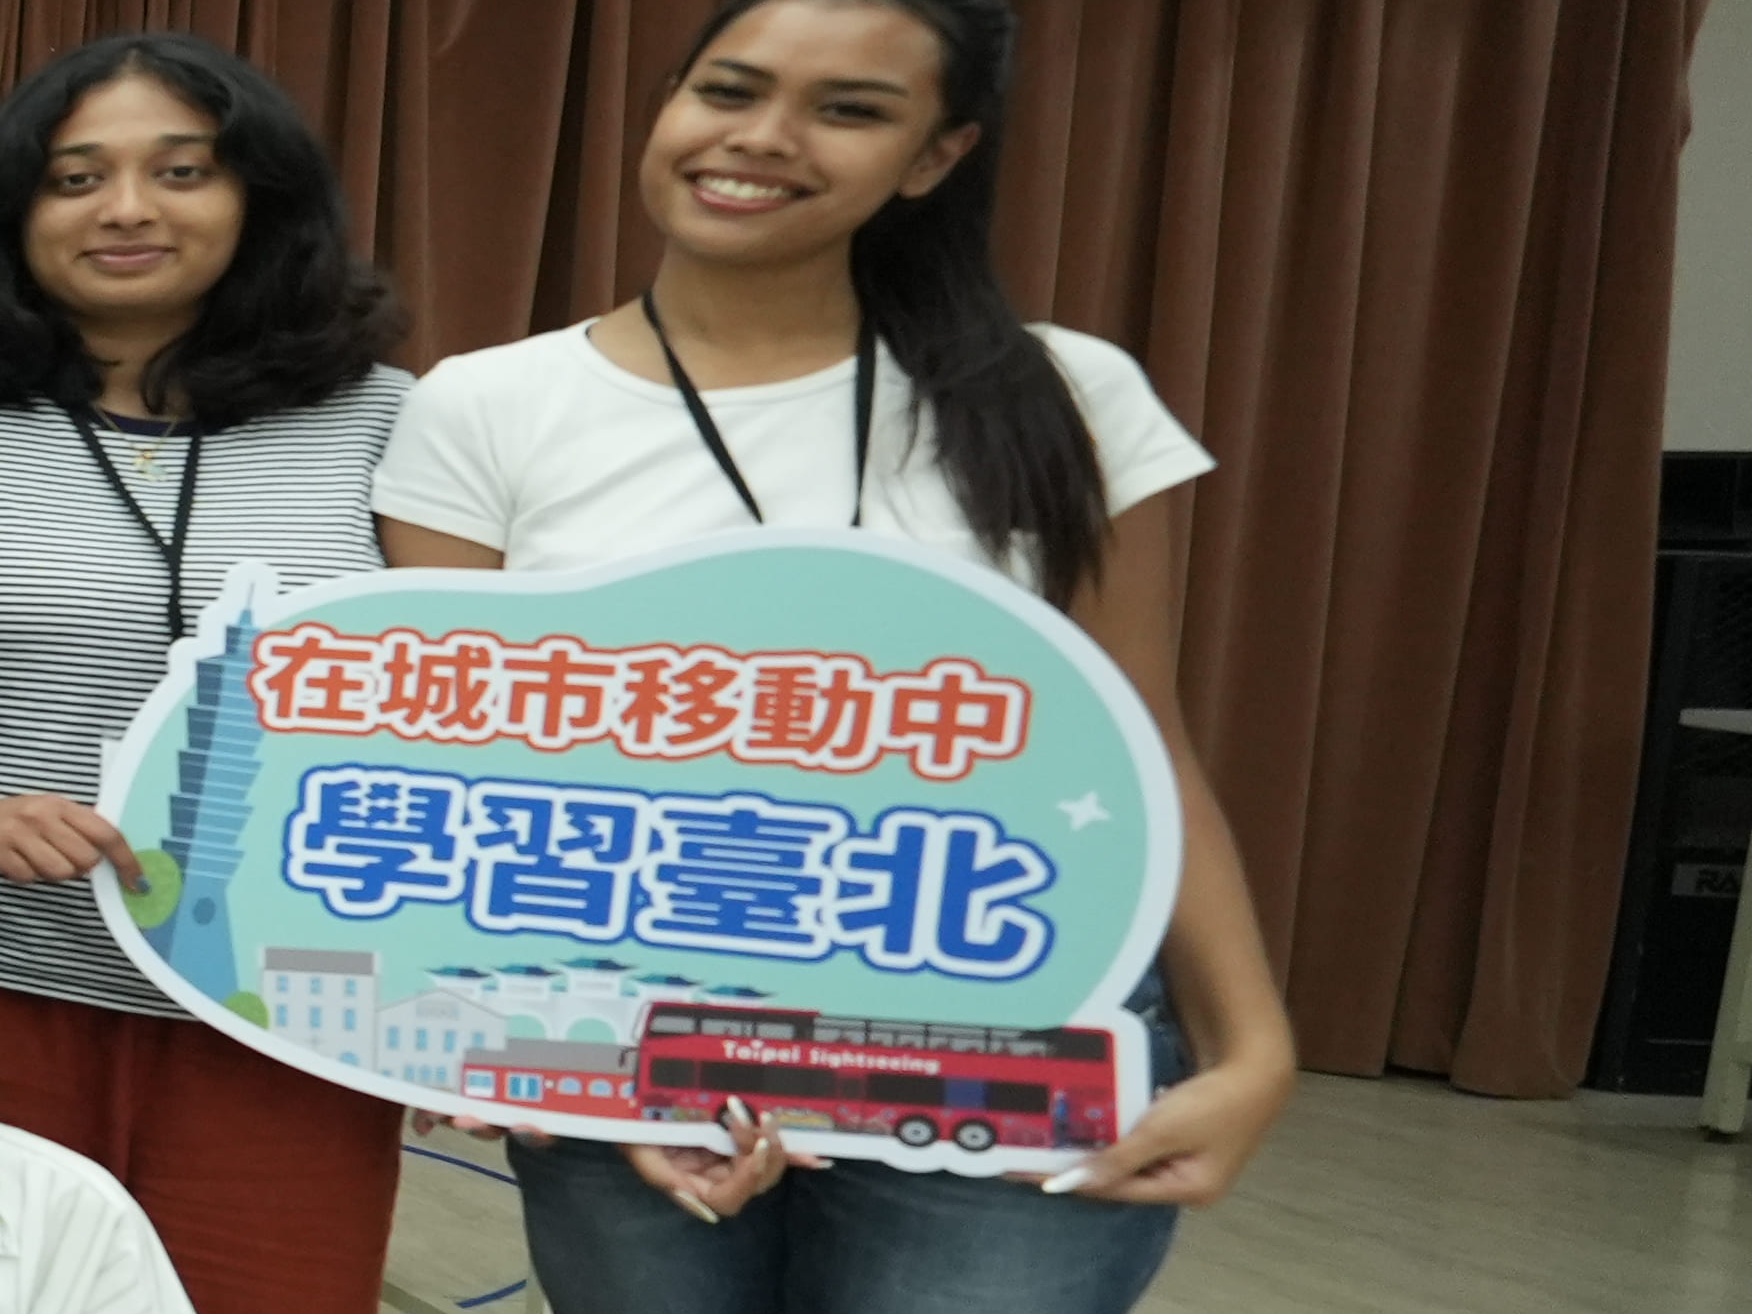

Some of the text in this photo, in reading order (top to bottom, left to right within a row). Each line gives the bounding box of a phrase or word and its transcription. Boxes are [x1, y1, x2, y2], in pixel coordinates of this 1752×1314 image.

[254, 624, 1028, 779] 在城市移動中
[288, 765, 1056, 980] 學習臺北
[722, 1038, 941, 1075] Taipei Sightseeing
